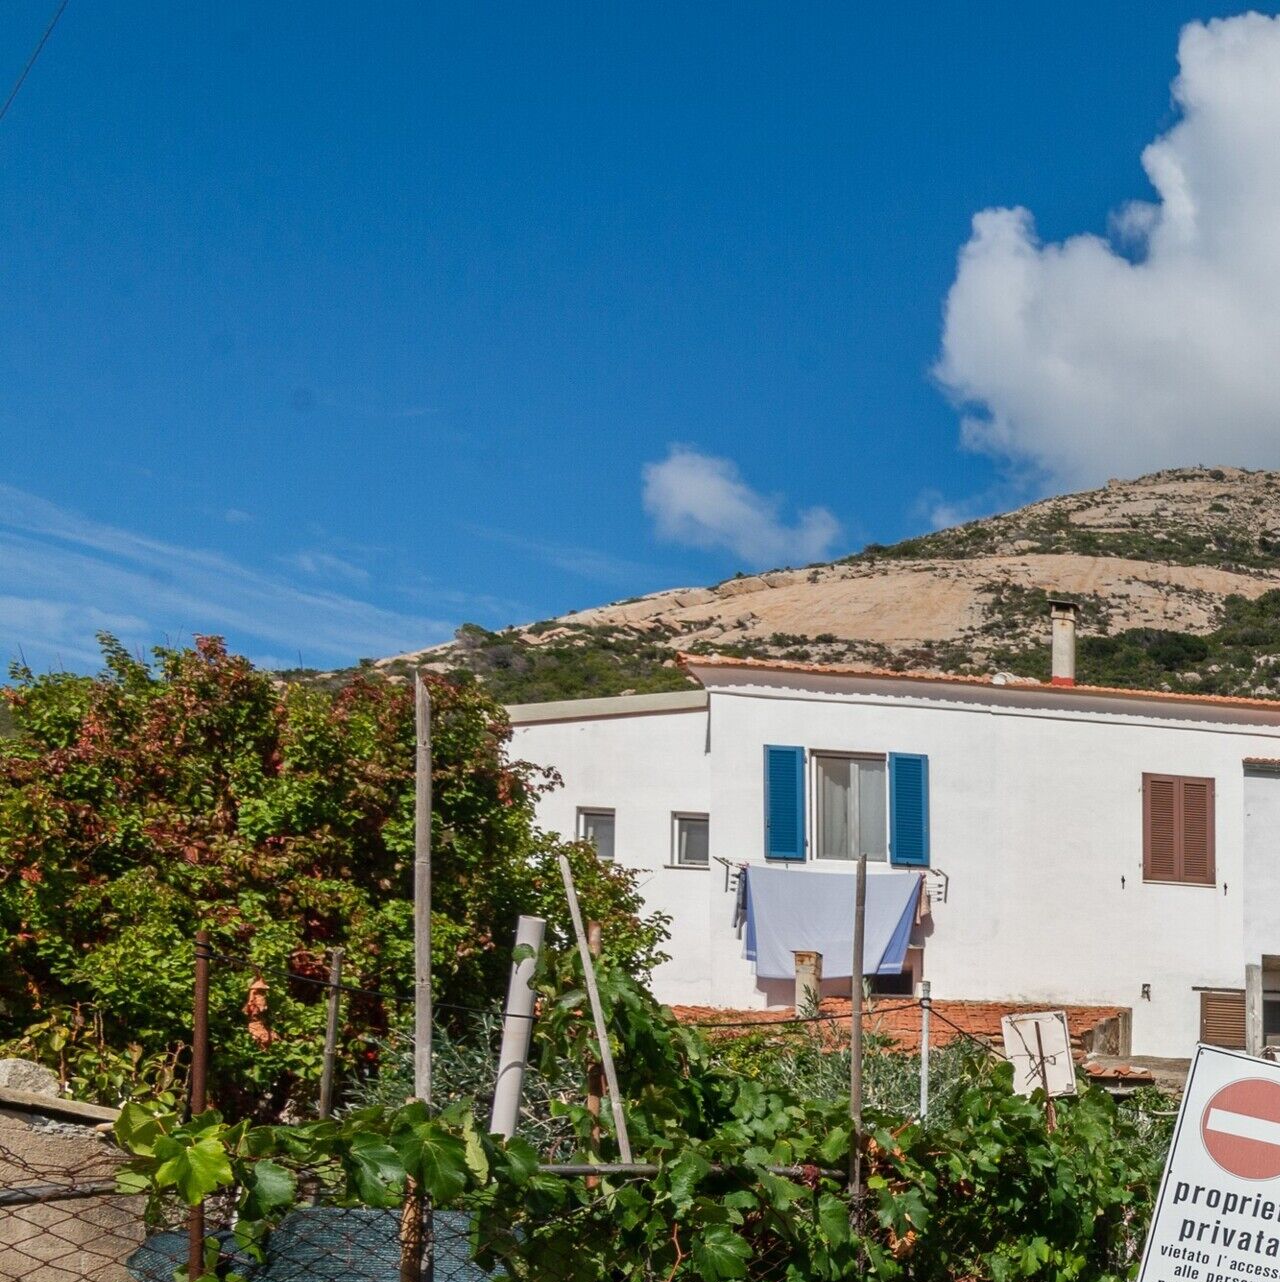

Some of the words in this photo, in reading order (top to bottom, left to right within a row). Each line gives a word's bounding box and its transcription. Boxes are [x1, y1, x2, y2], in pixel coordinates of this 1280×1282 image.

[1178, 1218, 1280, 1257] privata
[1160, 1244, 1210, 1265] vietato
[1173, 1264, 1199, 1280] alle
